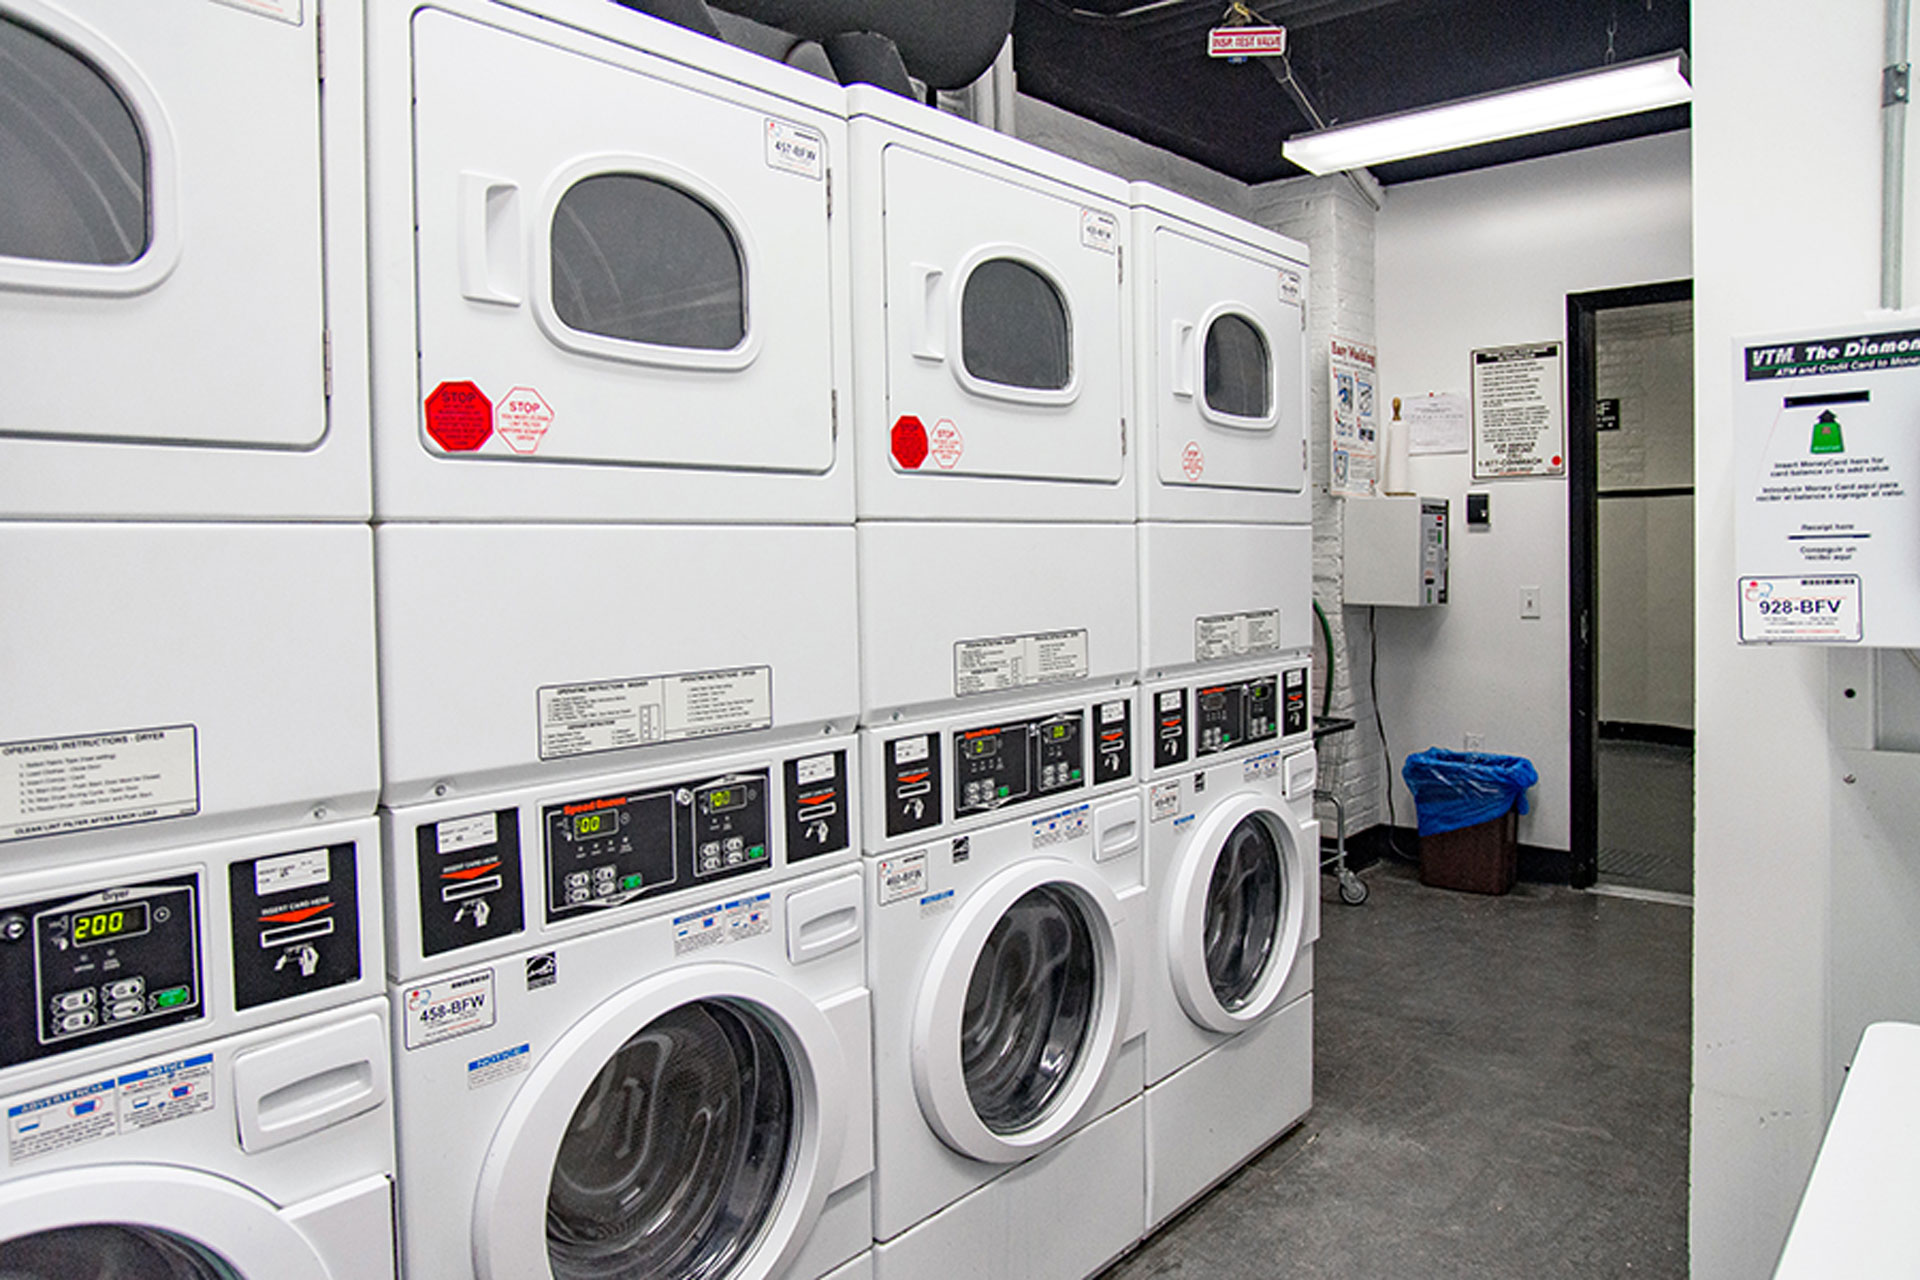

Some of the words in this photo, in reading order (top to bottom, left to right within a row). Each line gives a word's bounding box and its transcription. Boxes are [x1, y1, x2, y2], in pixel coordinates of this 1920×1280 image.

[1805, 345, 1839, 361] The
[1799, 365, 1817, 374] and
[1820, 362, 1848, 372] Credit
[1851, 359, 1875, 369] Card
[1877, 359, 1888, 367] to
[442, 392, 476, 403] STOP
[509, 401, 540, 414] STOP
[1800, 459, 1848, 468] MoneyCard
[1790, 468, 1823, 476] balance
[1878, 482, 1899, 490] para
[1800, 523, 1833, 531] Receipt
[1759, 600, 1842, 615] 928-BFV
[3, 742, 59, 756] OPERATING
[61, 736, 128, 750] INSTRUCTIONS
[135, 732, 165, 743] DRYER
[44, 822, 61, 830] LINT
[62, 818, 89, 827] FILTER
[90, 815, 115, 823] AFTER
[116, 812, 136, 820] EACH
[138, 809, 158, 818] LOAD
[102, 889, 129, 902] Dryer
[261, 904, 288, 916] INSERT
[289, 899, 310, 911] CARD
[74, 911, 124, 939] 200
[420, 993, 486, 1022] 458-BFW
